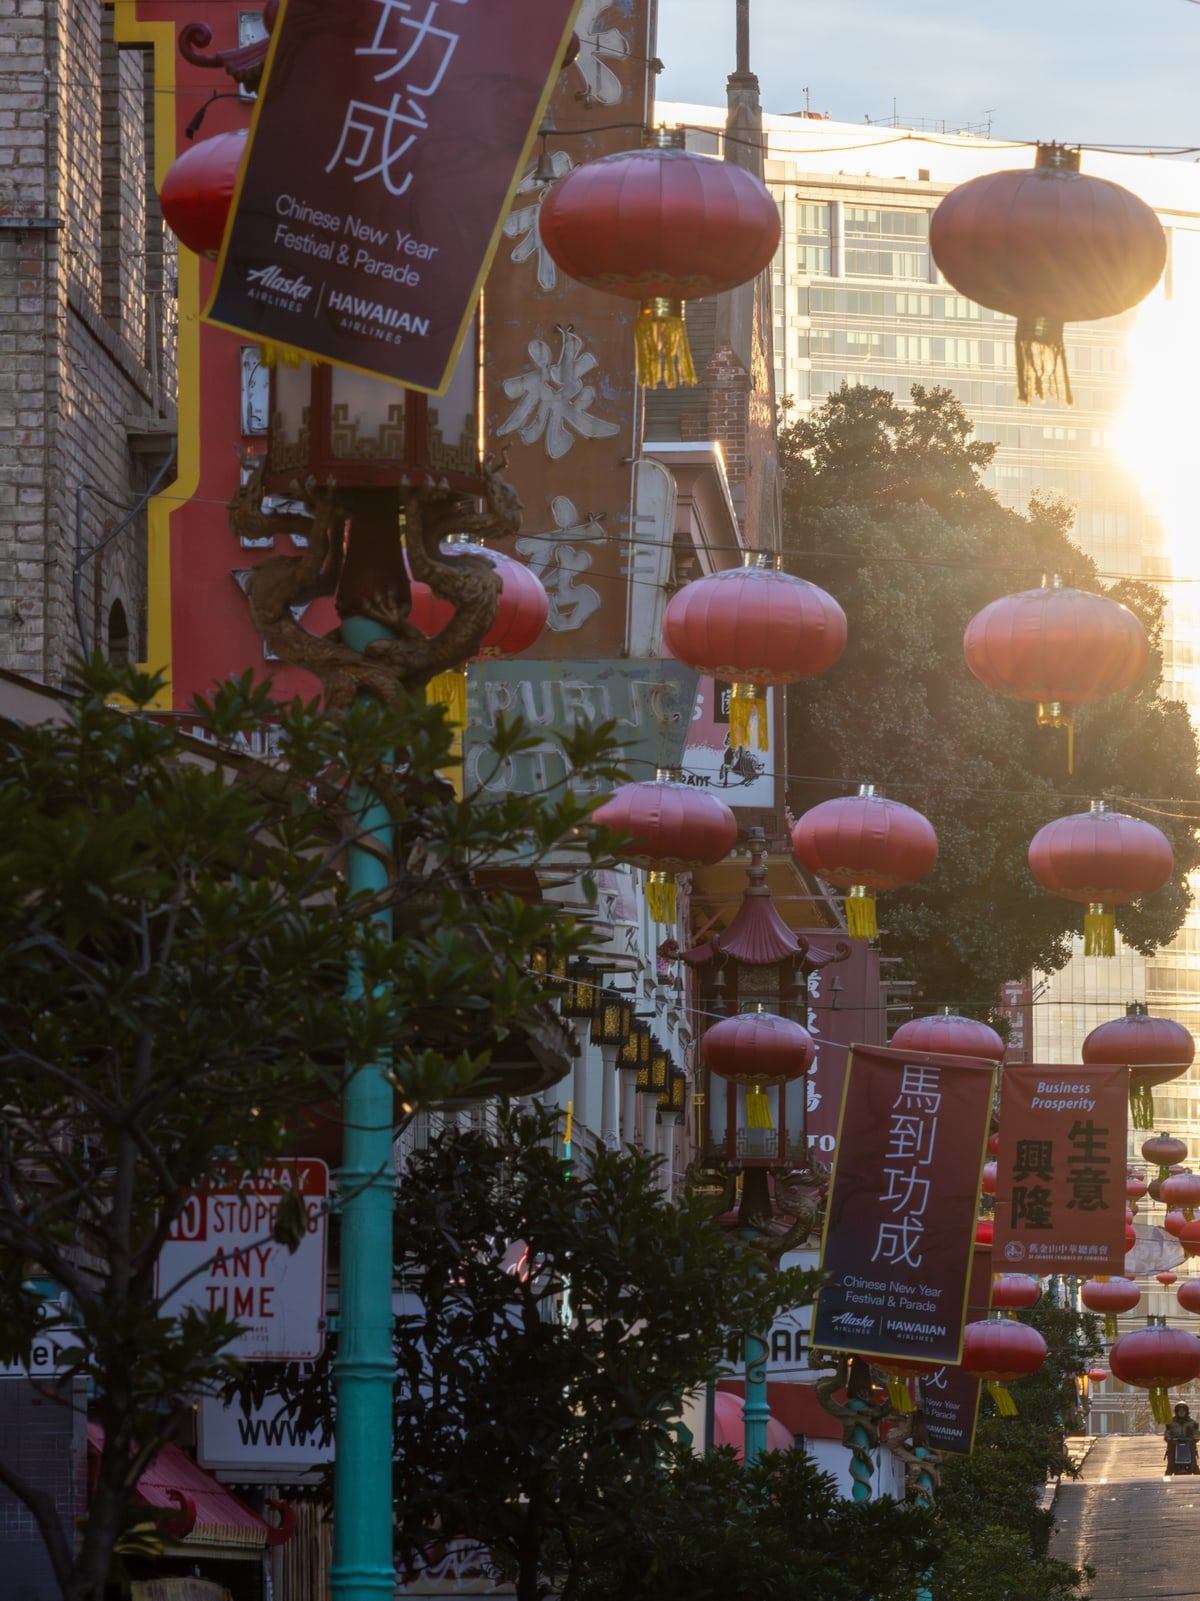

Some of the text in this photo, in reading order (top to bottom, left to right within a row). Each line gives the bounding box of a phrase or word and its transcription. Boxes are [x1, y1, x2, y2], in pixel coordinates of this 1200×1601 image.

[275, 194, 438, 262] Chinese New Year
[274, 225, 420, 287] Festival & Parade
[246, 264, 430, 337] Alaska HAWAIIAN
[247, 289, 403, 345] AIRLINES AIRLINES
[1037, 1081, 1091, 1094] Business
[1031, 1097, 1096, 1112] Prosperity
[871, 1064, 942, 1268] 馬到功成
[212, 1247, 272, 1277] ANY
[843, 1275, 943, 1297] Chinese New Year
[845, 1290, 936, 1312] Festival & Parade
[205, 1287, 274, 1317] TIME
[832, 1312, 946, 1336] Alaska HAWAIIAN
